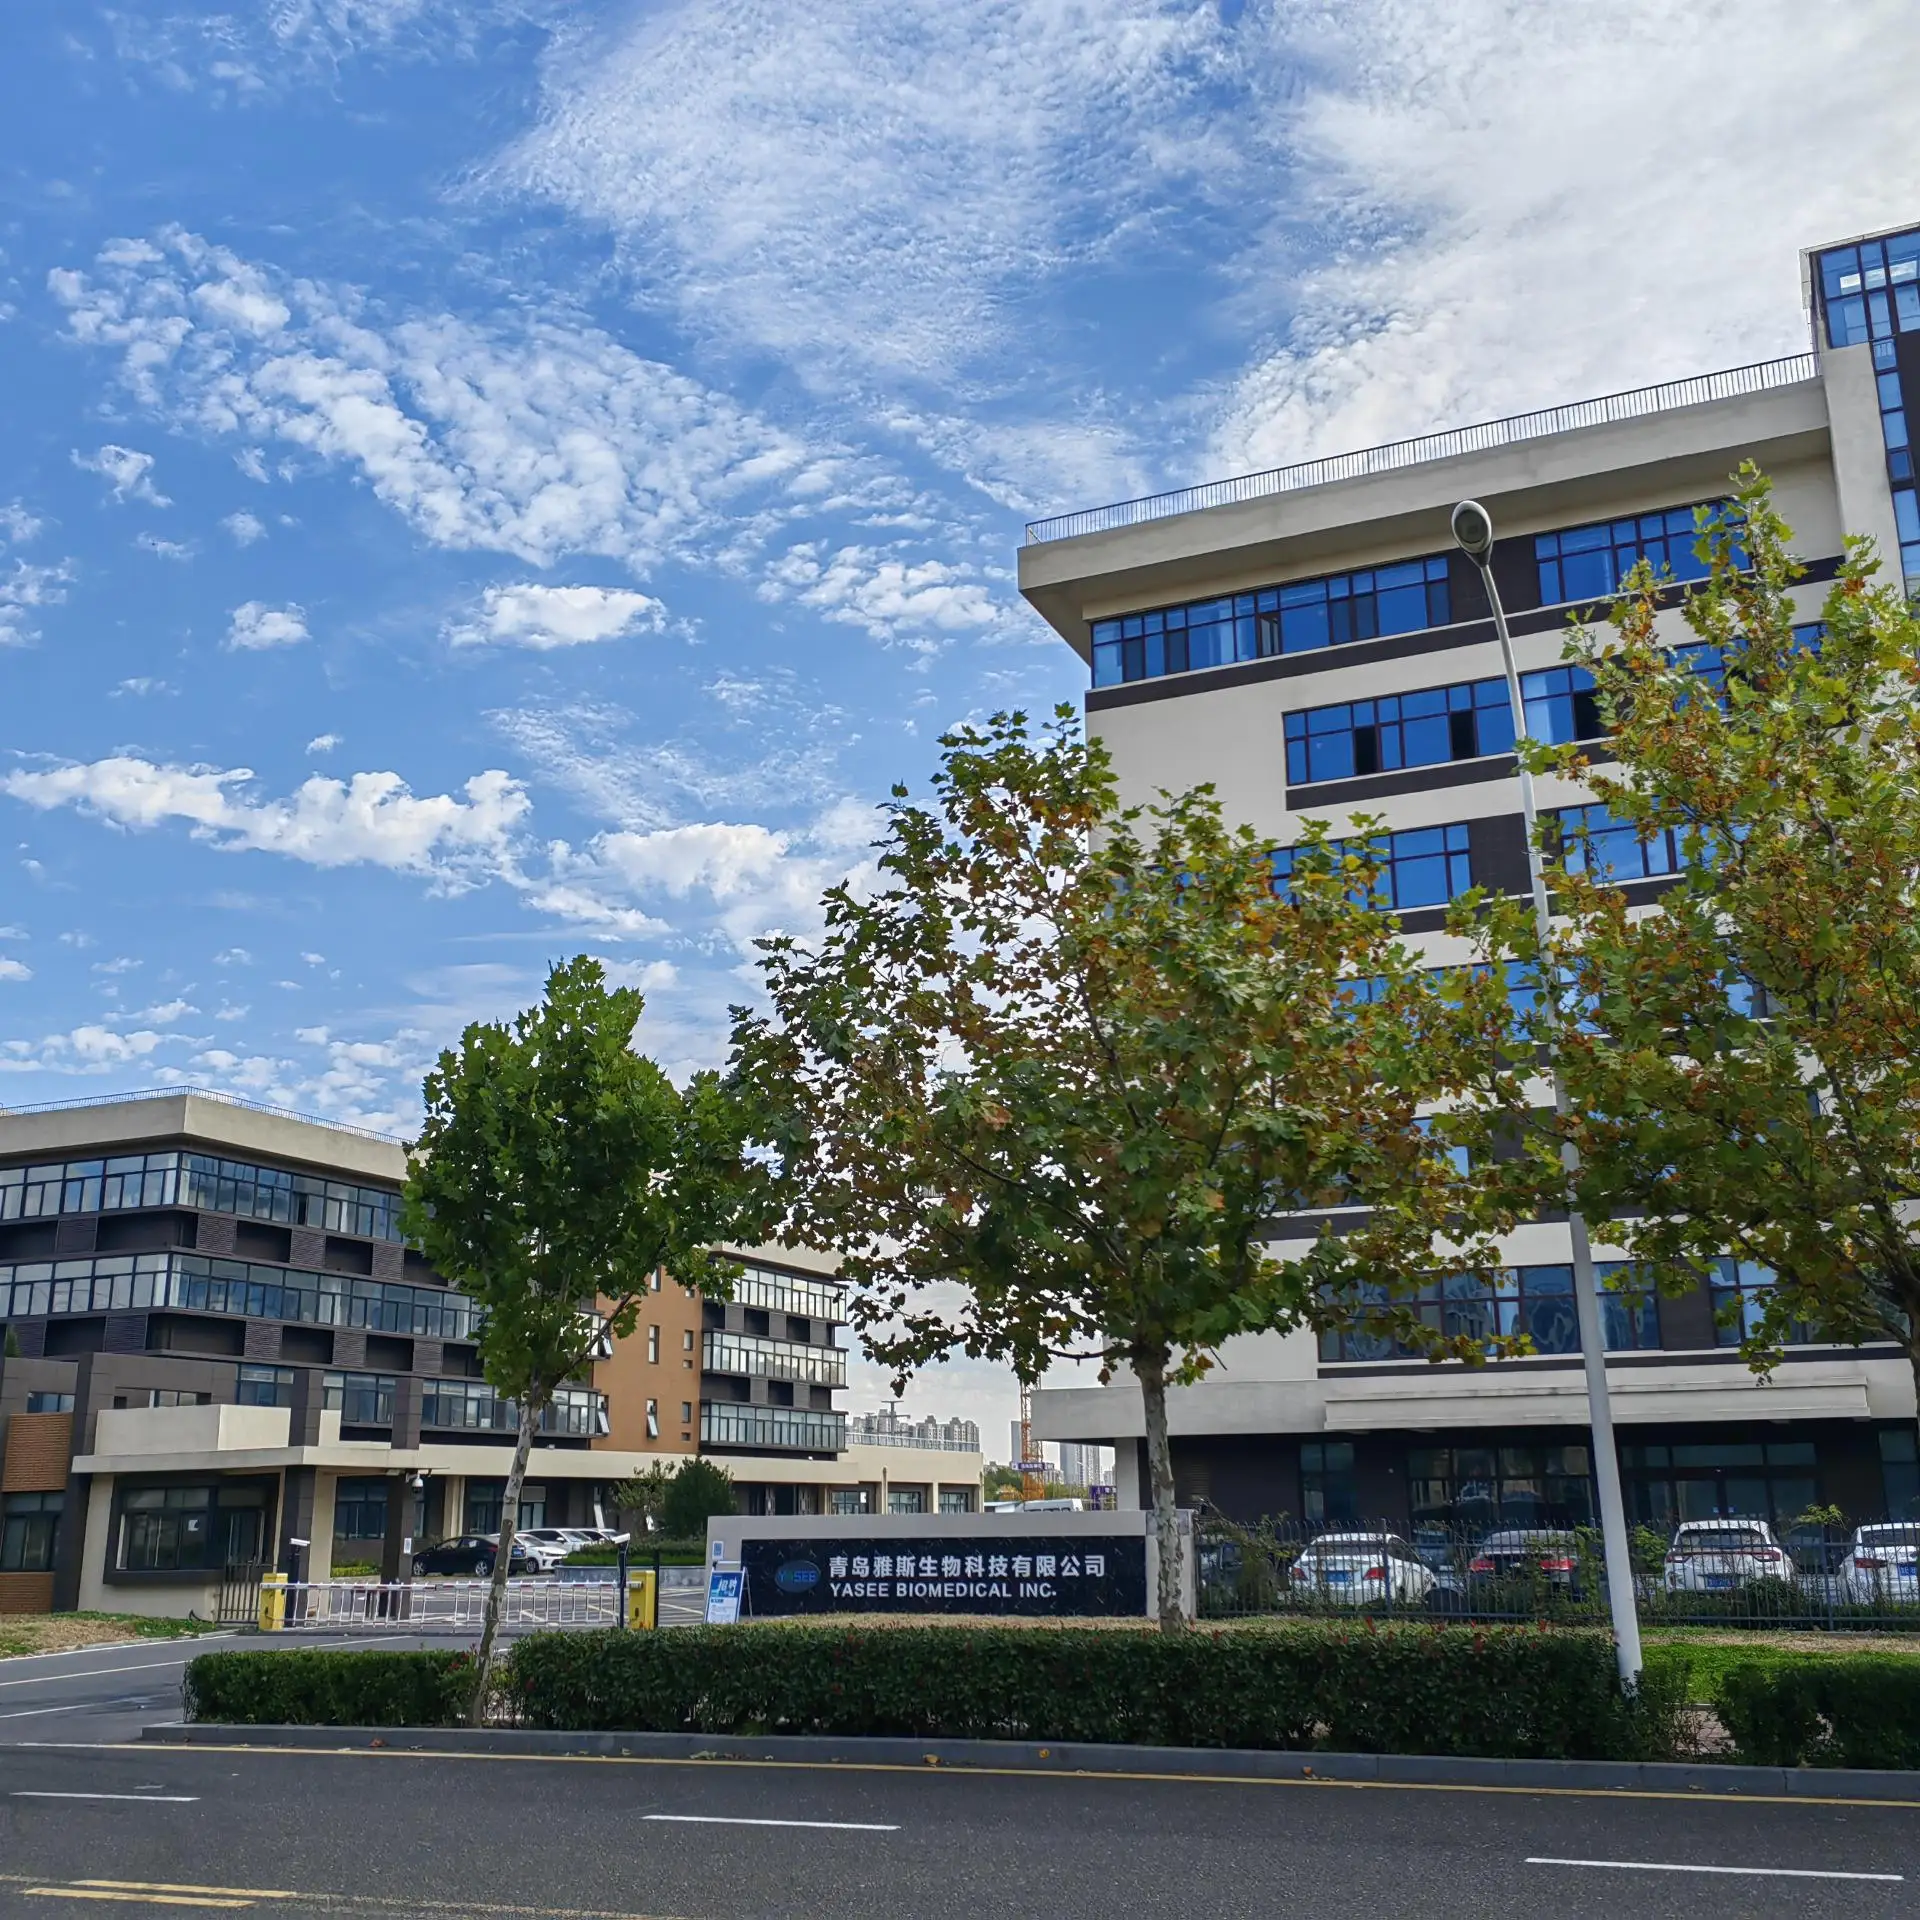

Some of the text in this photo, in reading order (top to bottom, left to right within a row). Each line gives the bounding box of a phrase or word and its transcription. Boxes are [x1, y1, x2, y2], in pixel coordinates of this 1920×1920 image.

[829, 1555, 1105, 1578] 青岛雅斯生物科技有限公司
[830, 1582, 1057, 1597] YASEE BIOMEDICAL INC.
